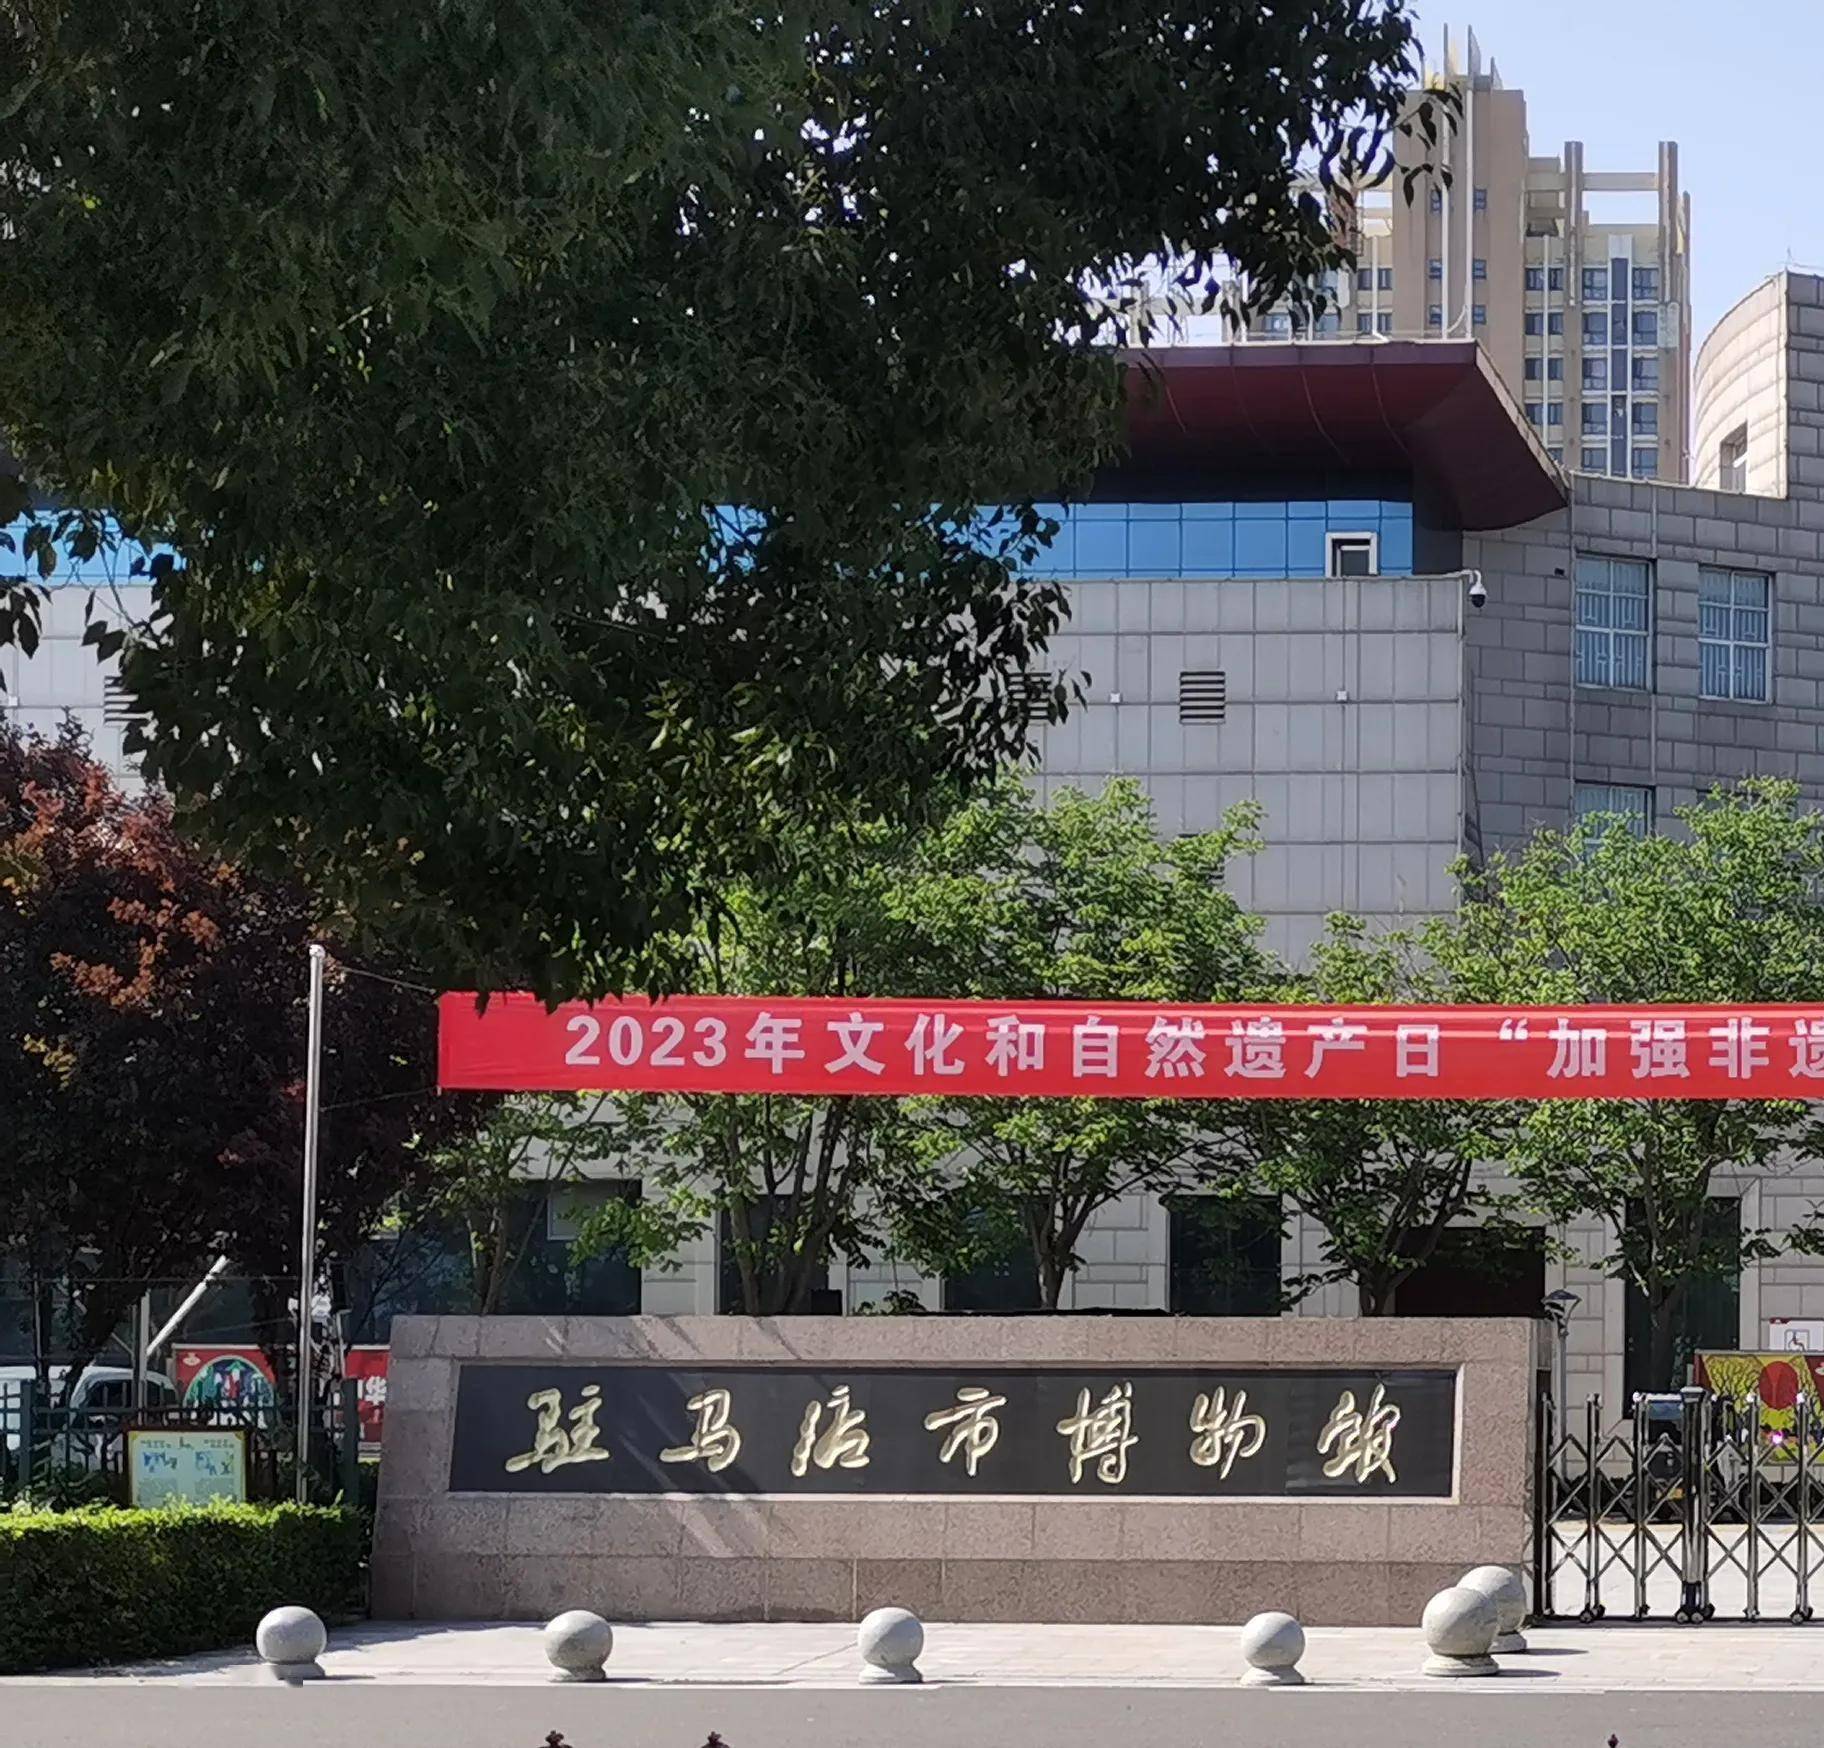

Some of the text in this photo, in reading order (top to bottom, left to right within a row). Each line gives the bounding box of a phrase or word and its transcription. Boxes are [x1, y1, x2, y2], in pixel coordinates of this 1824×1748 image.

[565, 1011, 1440, 1078] 2023年文化和自然遗产日
[505, 1381, 1402, 1485] 驻马店市博物馆
